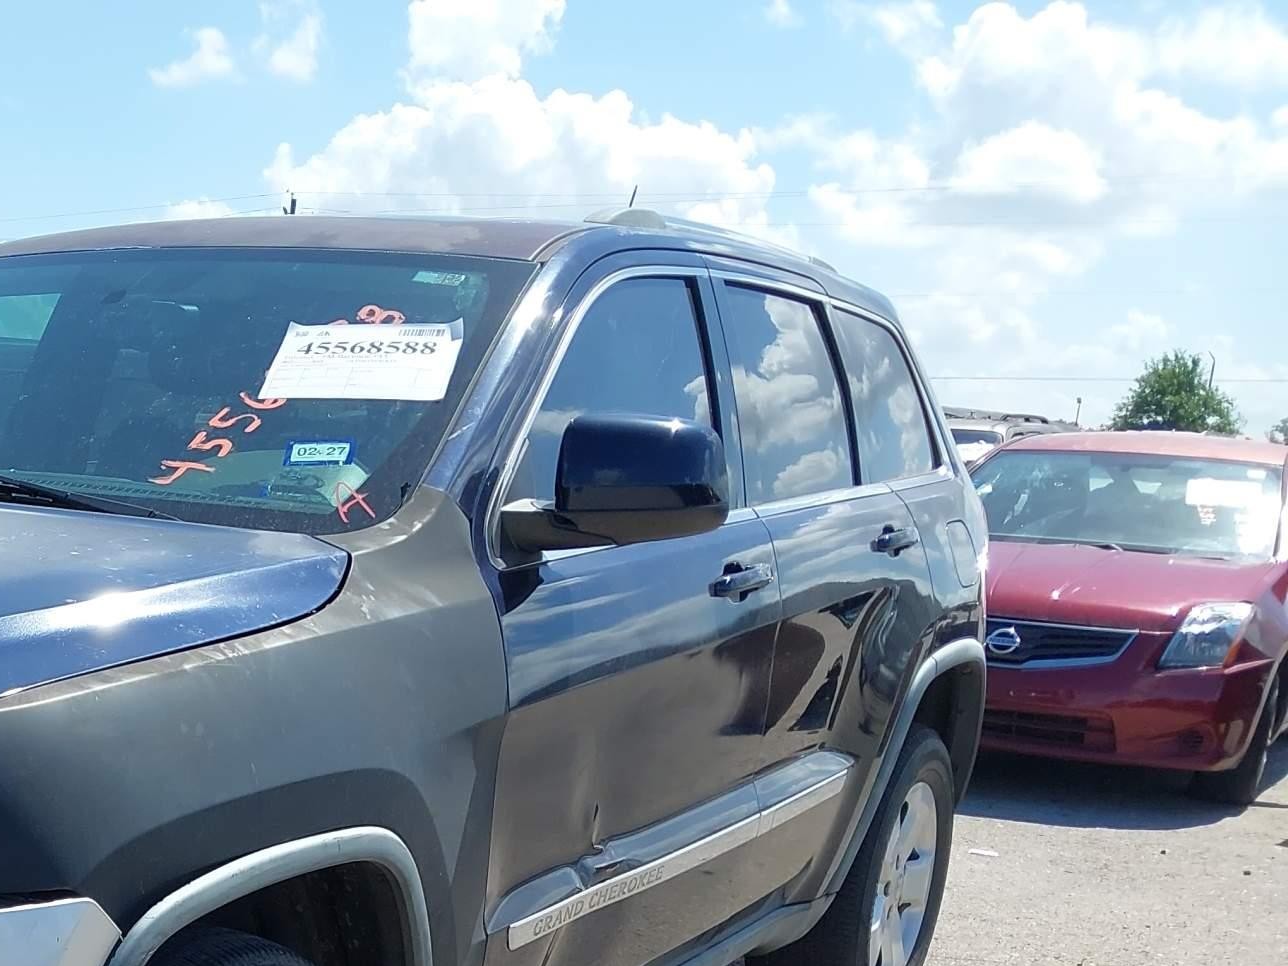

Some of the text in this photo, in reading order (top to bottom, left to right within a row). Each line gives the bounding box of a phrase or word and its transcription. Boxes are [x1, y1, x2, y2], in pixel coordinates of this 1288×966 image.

[297, 340, 437, 355] 45568588
[533, 865, 665, 936] GRAND CHEROKEE
